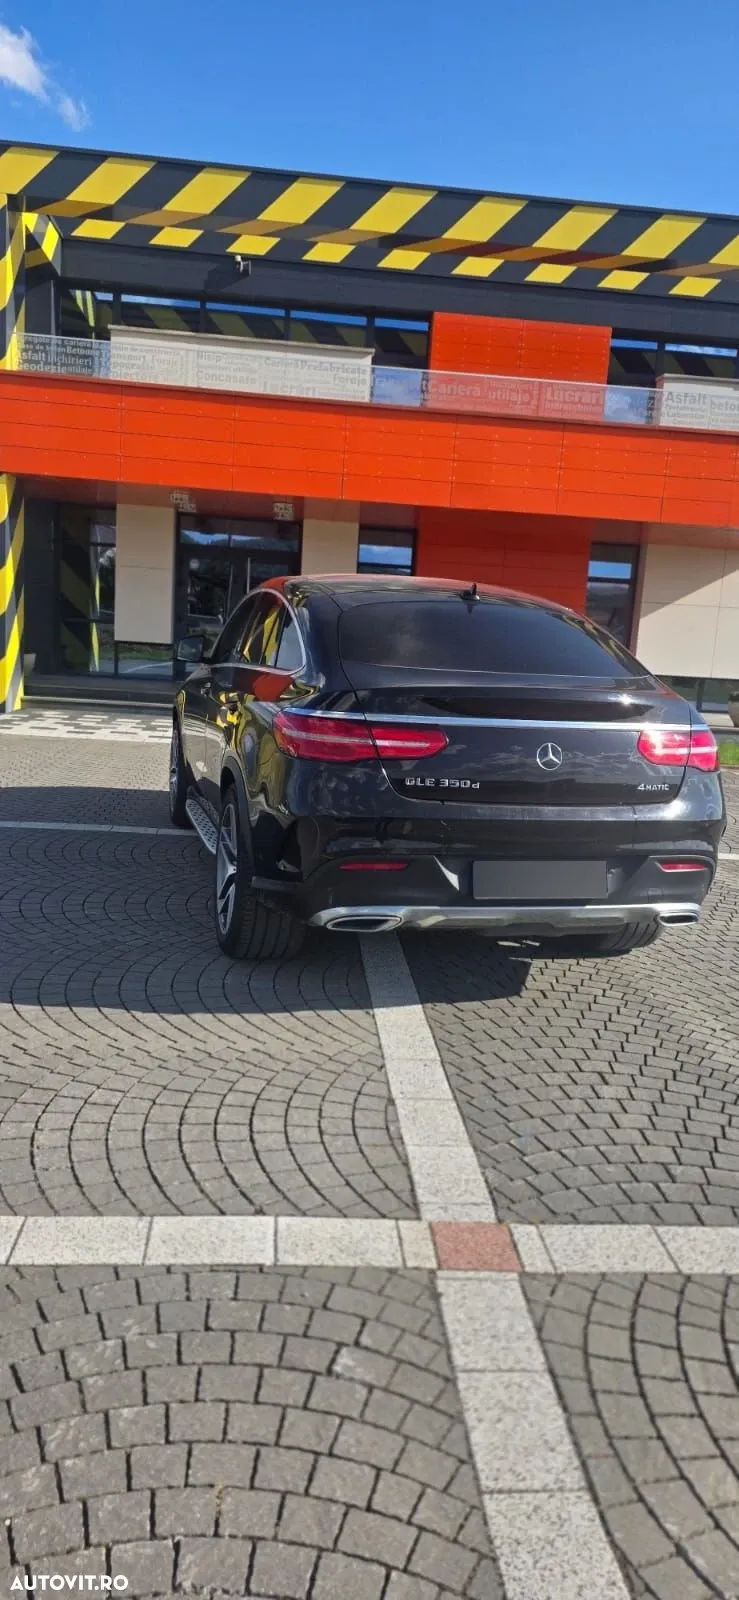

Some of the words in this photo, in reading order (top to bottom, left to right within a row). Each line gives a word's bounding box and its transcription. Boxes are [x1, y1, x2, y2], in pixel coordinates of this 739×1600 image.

[665, 391, 708, 405] Asfalt
[405, 777, 435, 787] GLE
[637, 783, 670, 791] 4MATIC
